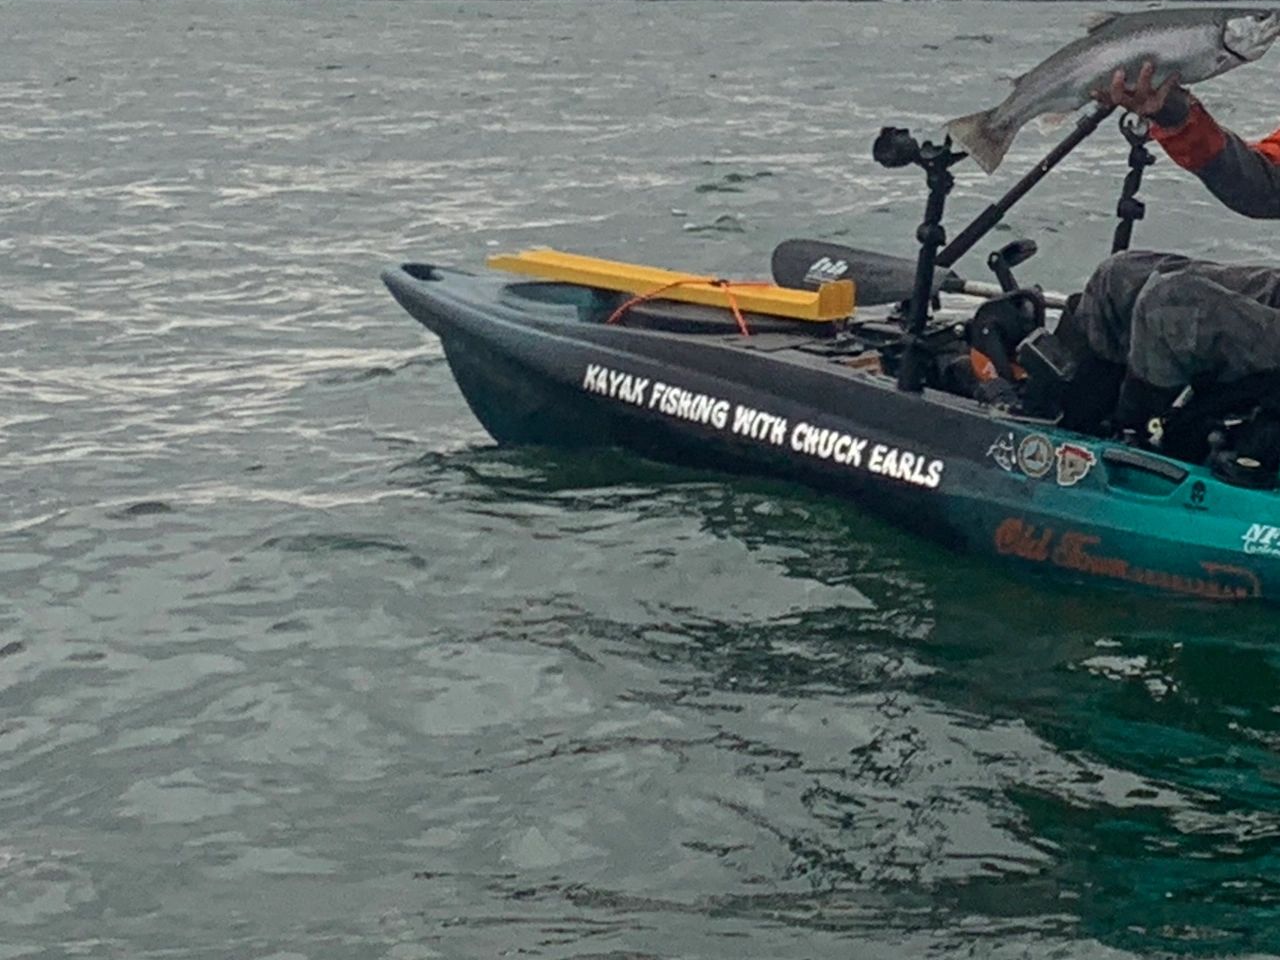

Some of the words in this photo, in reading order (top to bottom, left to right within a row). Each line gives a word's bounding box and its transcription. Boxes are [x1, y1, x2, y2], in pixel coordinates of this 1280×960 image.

[583, 363, 650, 406] KAYAK
[648, 382, 730, 429] FISHING
[732, 405, 787, 445] WITH
[791, 422, 868, 467] CHUCK
[868, 444, 944, 488] EARLS
